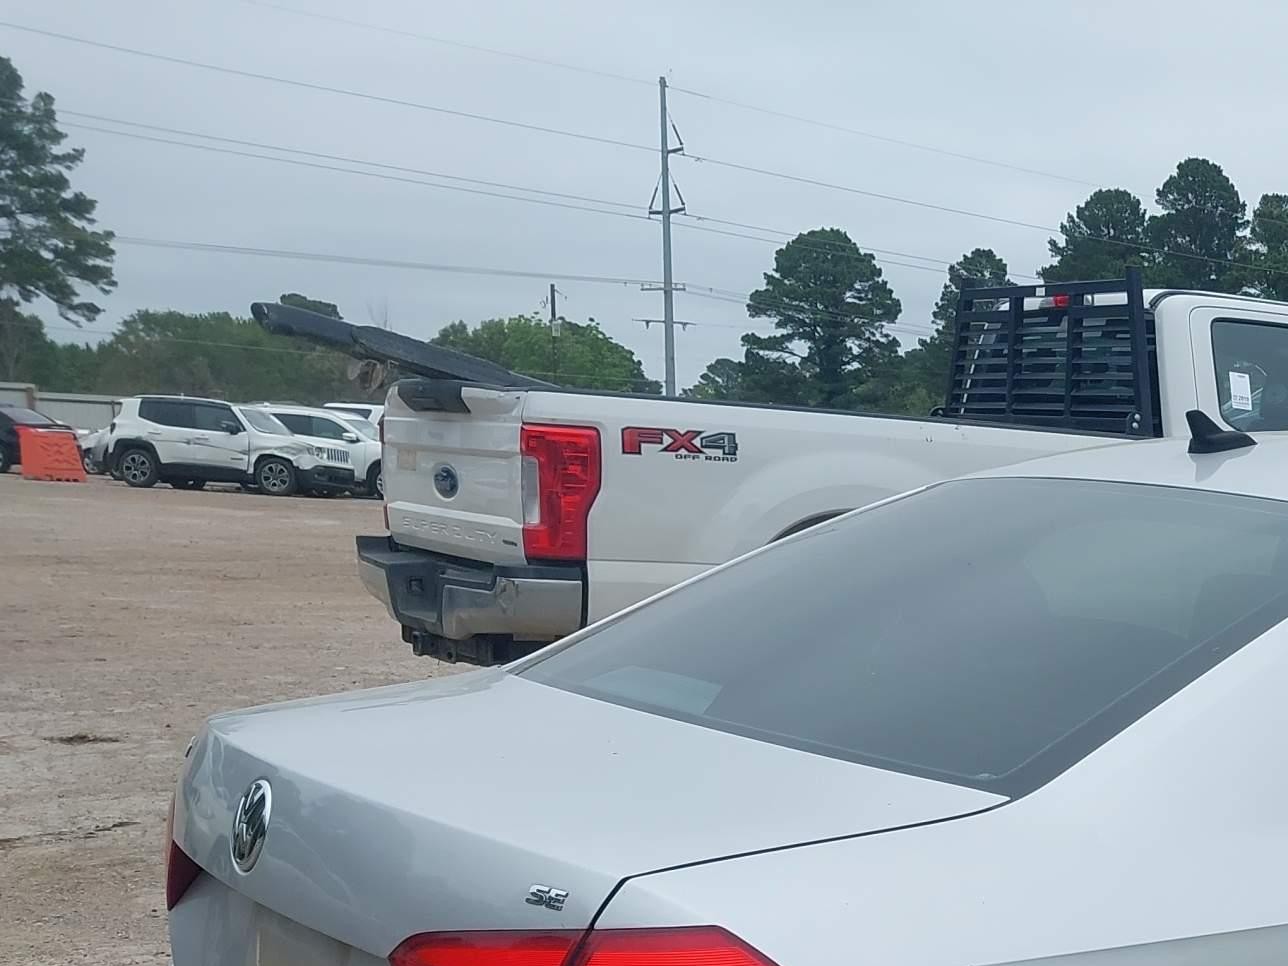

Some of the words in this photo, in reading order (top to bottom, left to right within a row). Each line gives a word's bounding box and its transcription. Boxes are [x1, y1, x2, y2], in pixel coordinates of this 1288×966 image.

[621, 426, 738, 456] FX4
[675, 453, 701, 461] OFF
[704, 455, 738, 463] ROAD
[525, 884, 569, 912] SE
